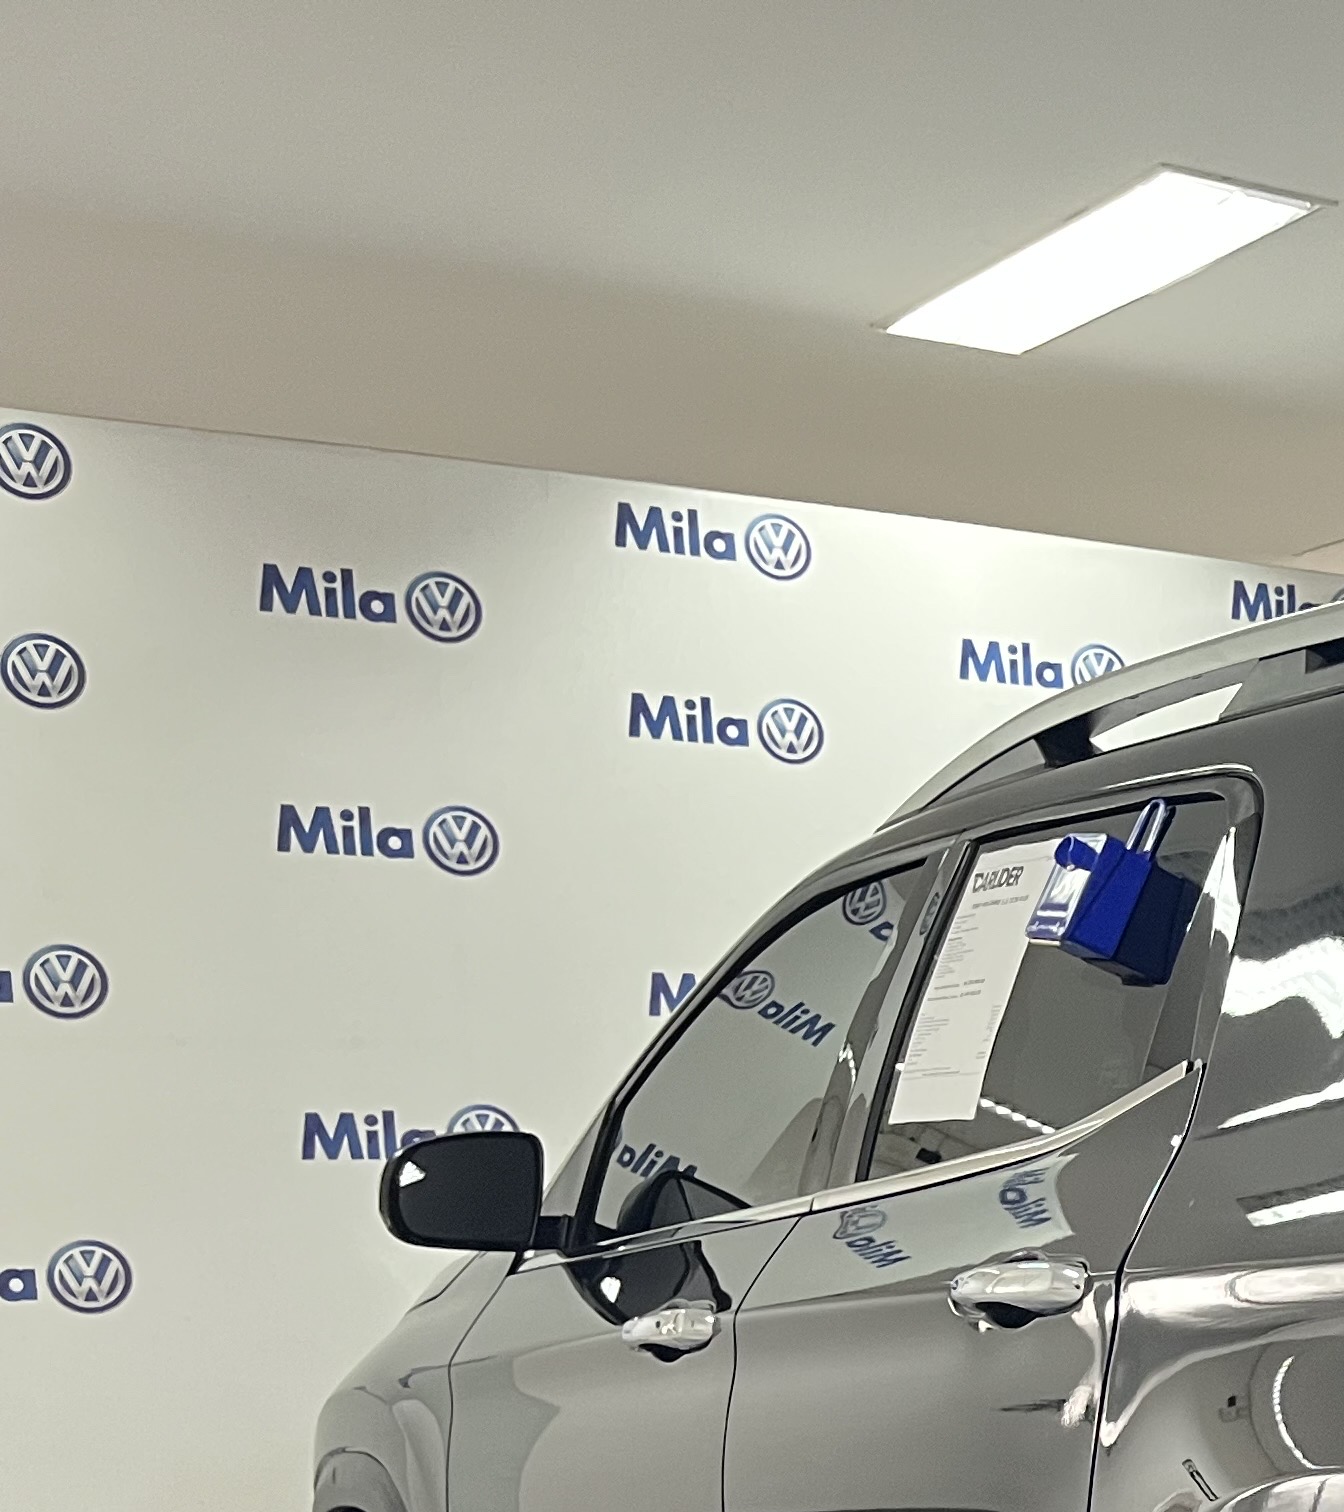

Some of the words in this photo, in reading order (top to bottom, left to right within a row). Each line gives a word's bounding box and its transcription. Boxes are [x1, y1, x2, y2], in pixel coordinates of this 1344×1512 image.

[614, 501, 737, 562] Mila
[259, 562, 397, 624] Mila
[1231, 579, 1322, 623] Mil
[959, 638, 1064, 690] Mila
[628, 692, 750, 747] Mila
[276, 803, 415, 859] Mila
